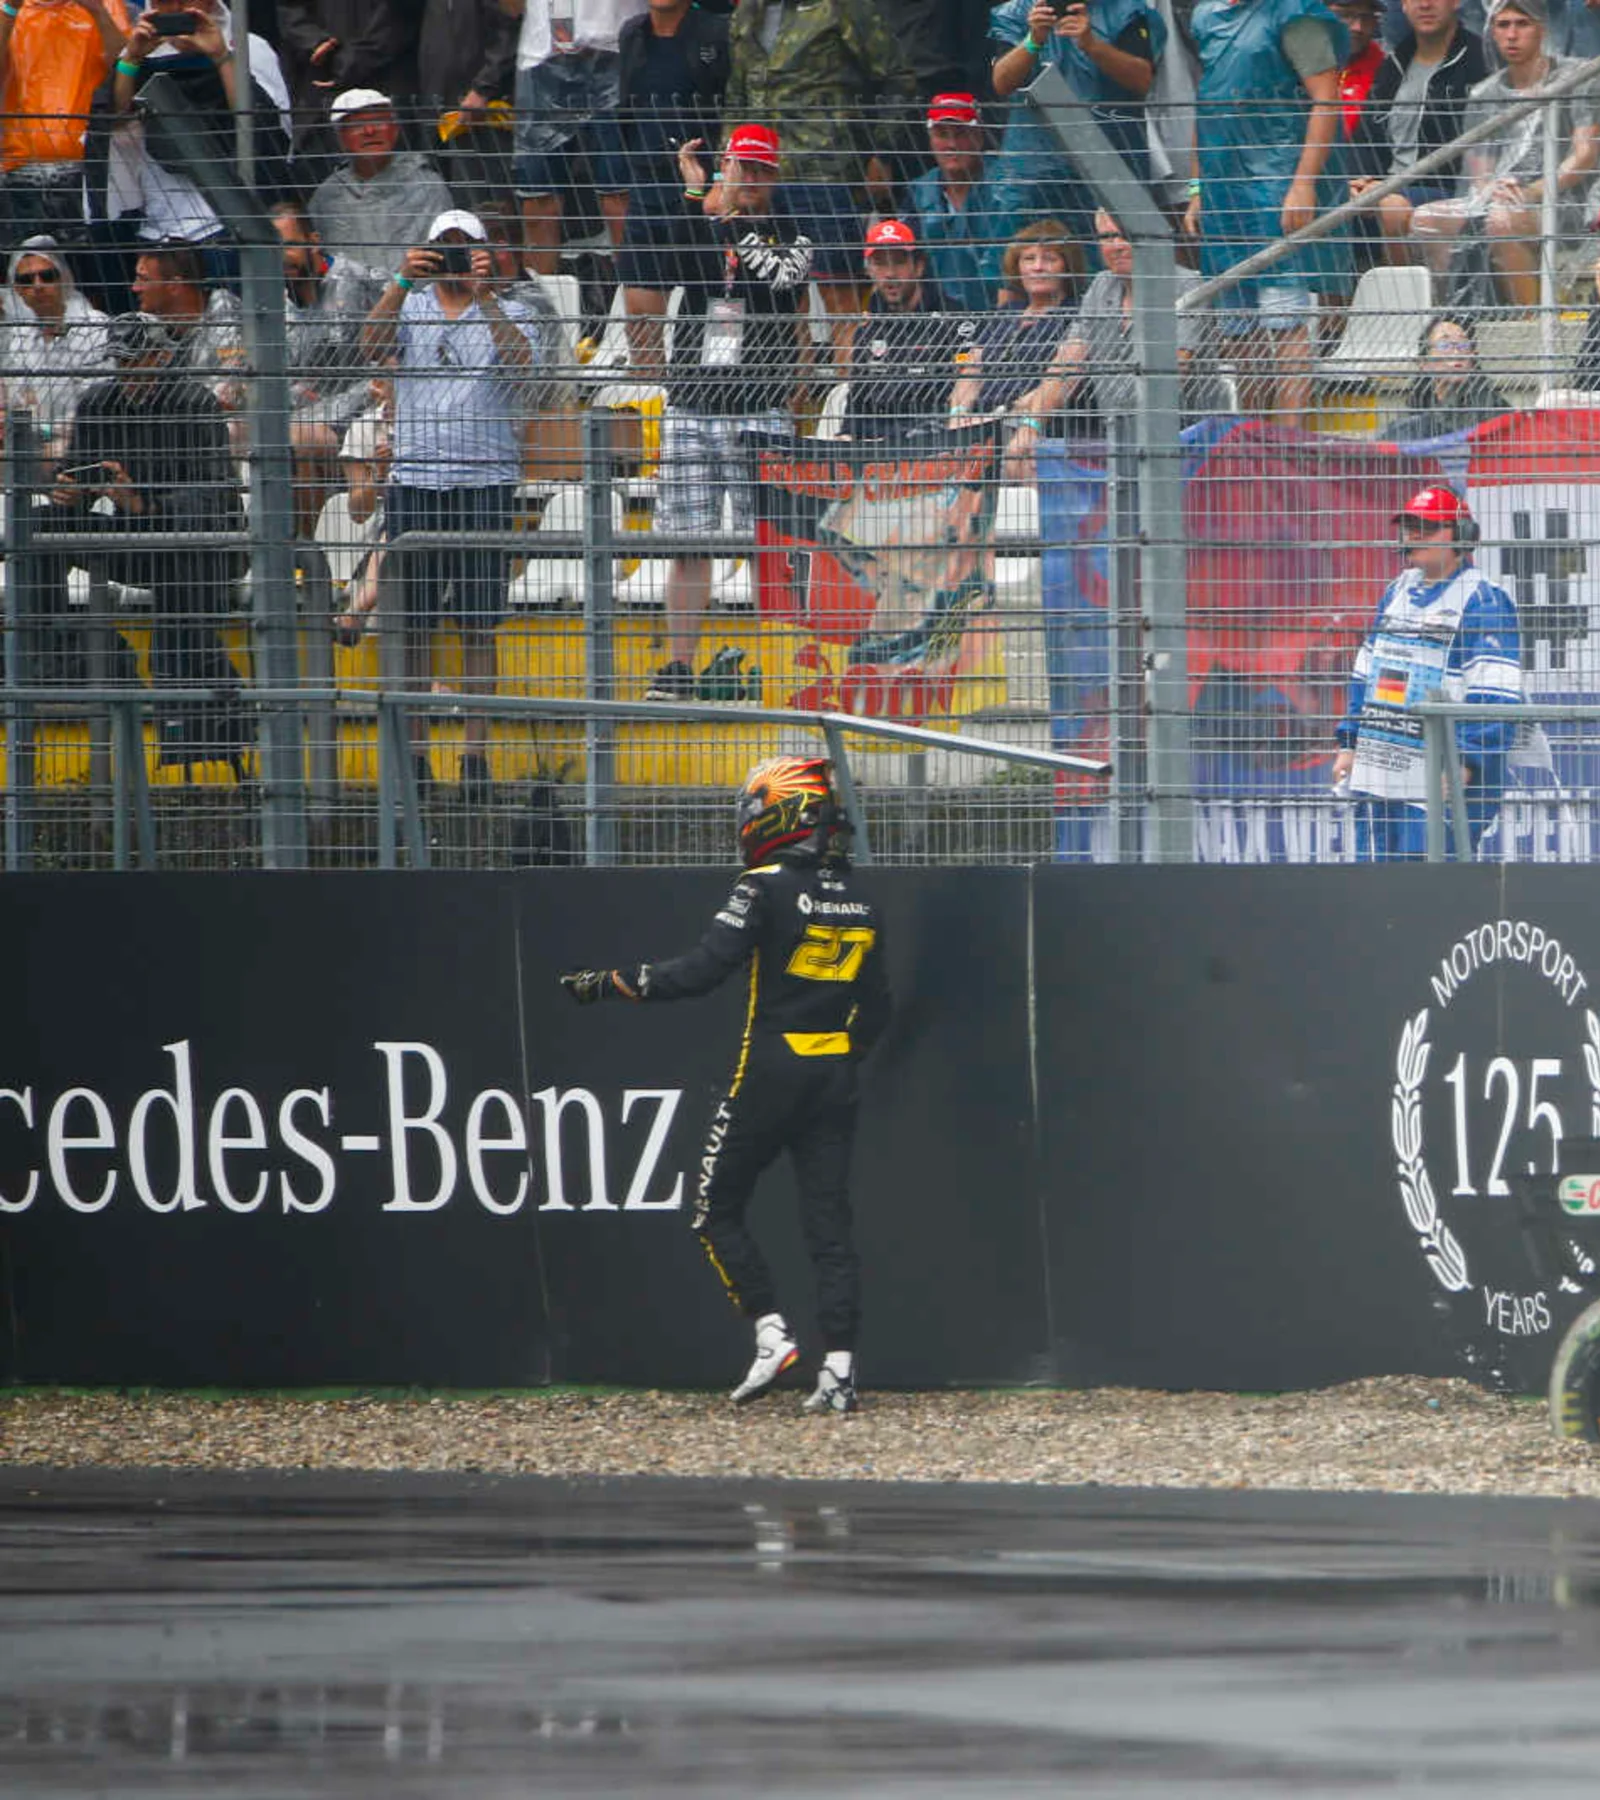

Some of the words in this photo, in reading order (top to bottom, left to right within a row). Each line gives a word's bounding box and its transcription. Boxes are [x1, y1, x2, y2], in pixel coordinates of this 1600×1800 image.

[786, 924, 876, 981] 27
[1430, 921, 1588, 1008] MOTORSPORT
[1444, 1053, 1564, 1196] 125
[1483, 1286, 1551, 1335] YEARS
